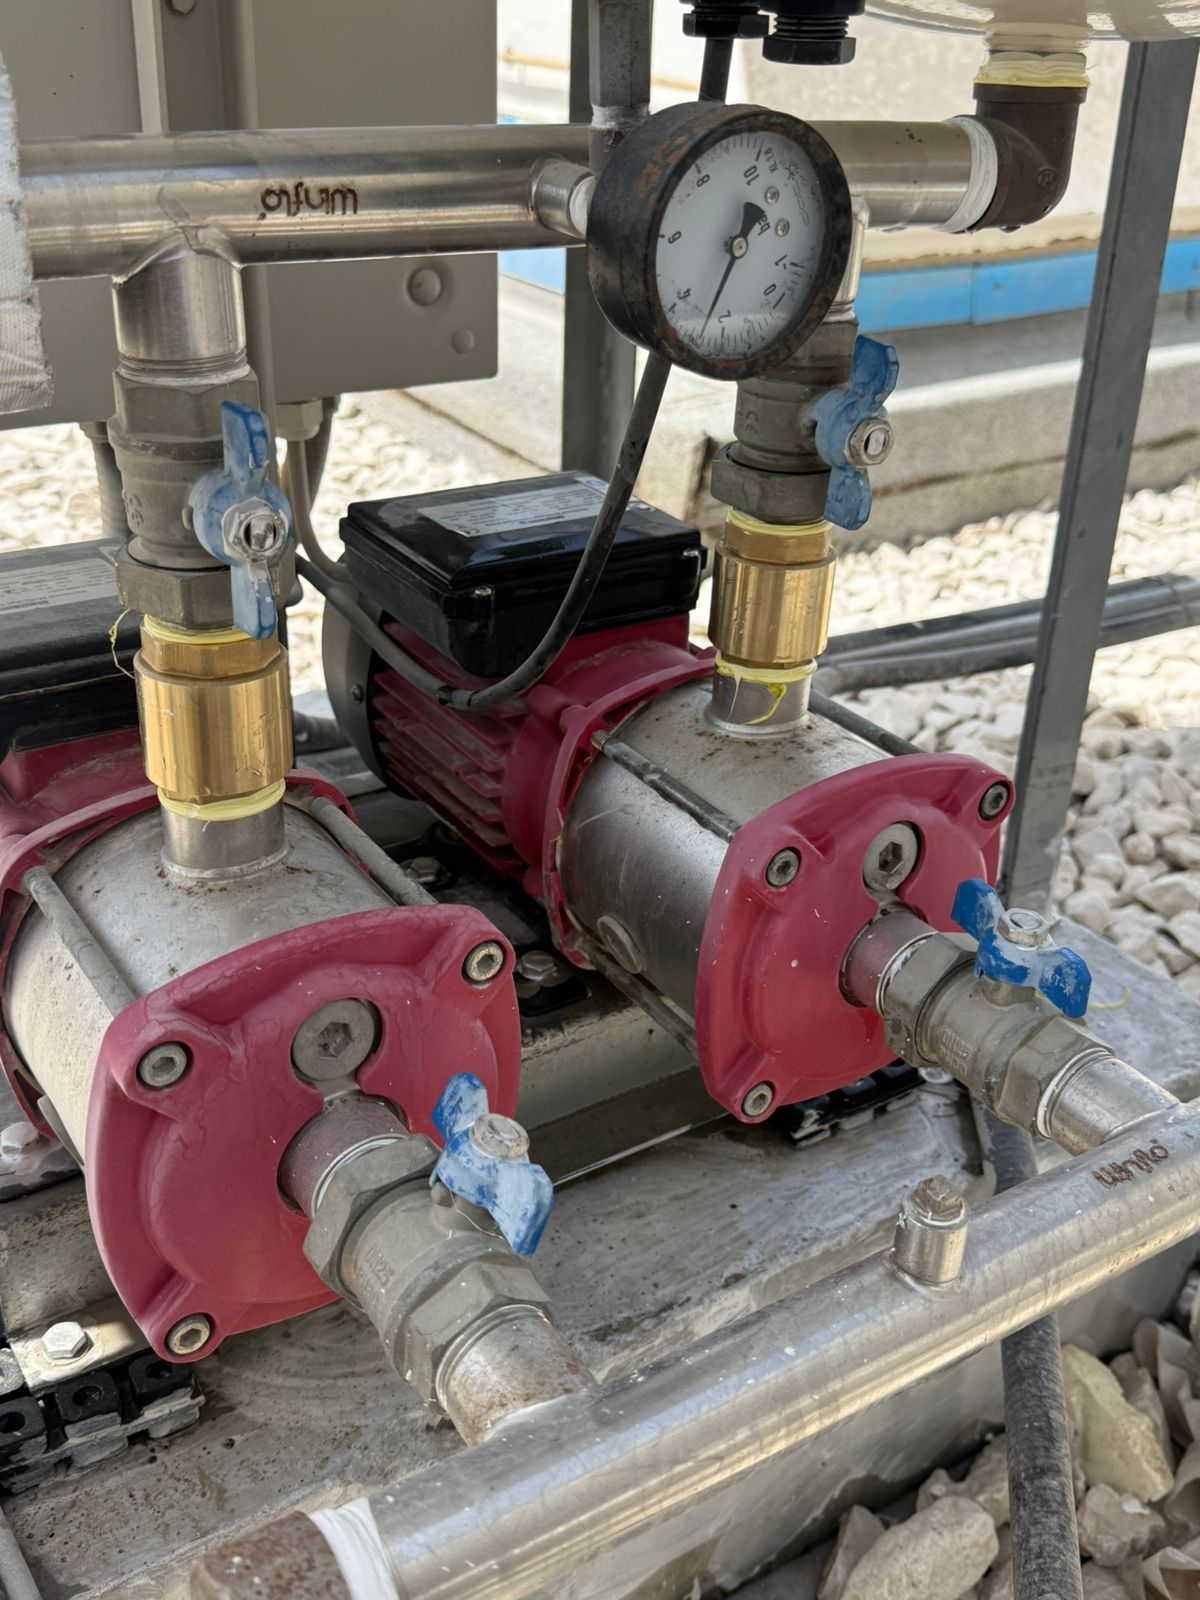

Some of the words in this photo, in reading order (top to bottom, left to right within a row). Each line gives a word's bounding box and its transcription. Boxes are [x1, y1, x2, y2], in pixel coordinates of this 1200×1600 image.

[696, 173, 711, 188] 8
[743, 165, 760, 186] 10
[757, 213, 771, 236] ba
[667, 230, 682, 244] 6
[774, 254, 788, 270] -1
[676, 287, 692, 300] 4
[763, 283, 777, 296] 0
[717, 309, 732, 323] 2
